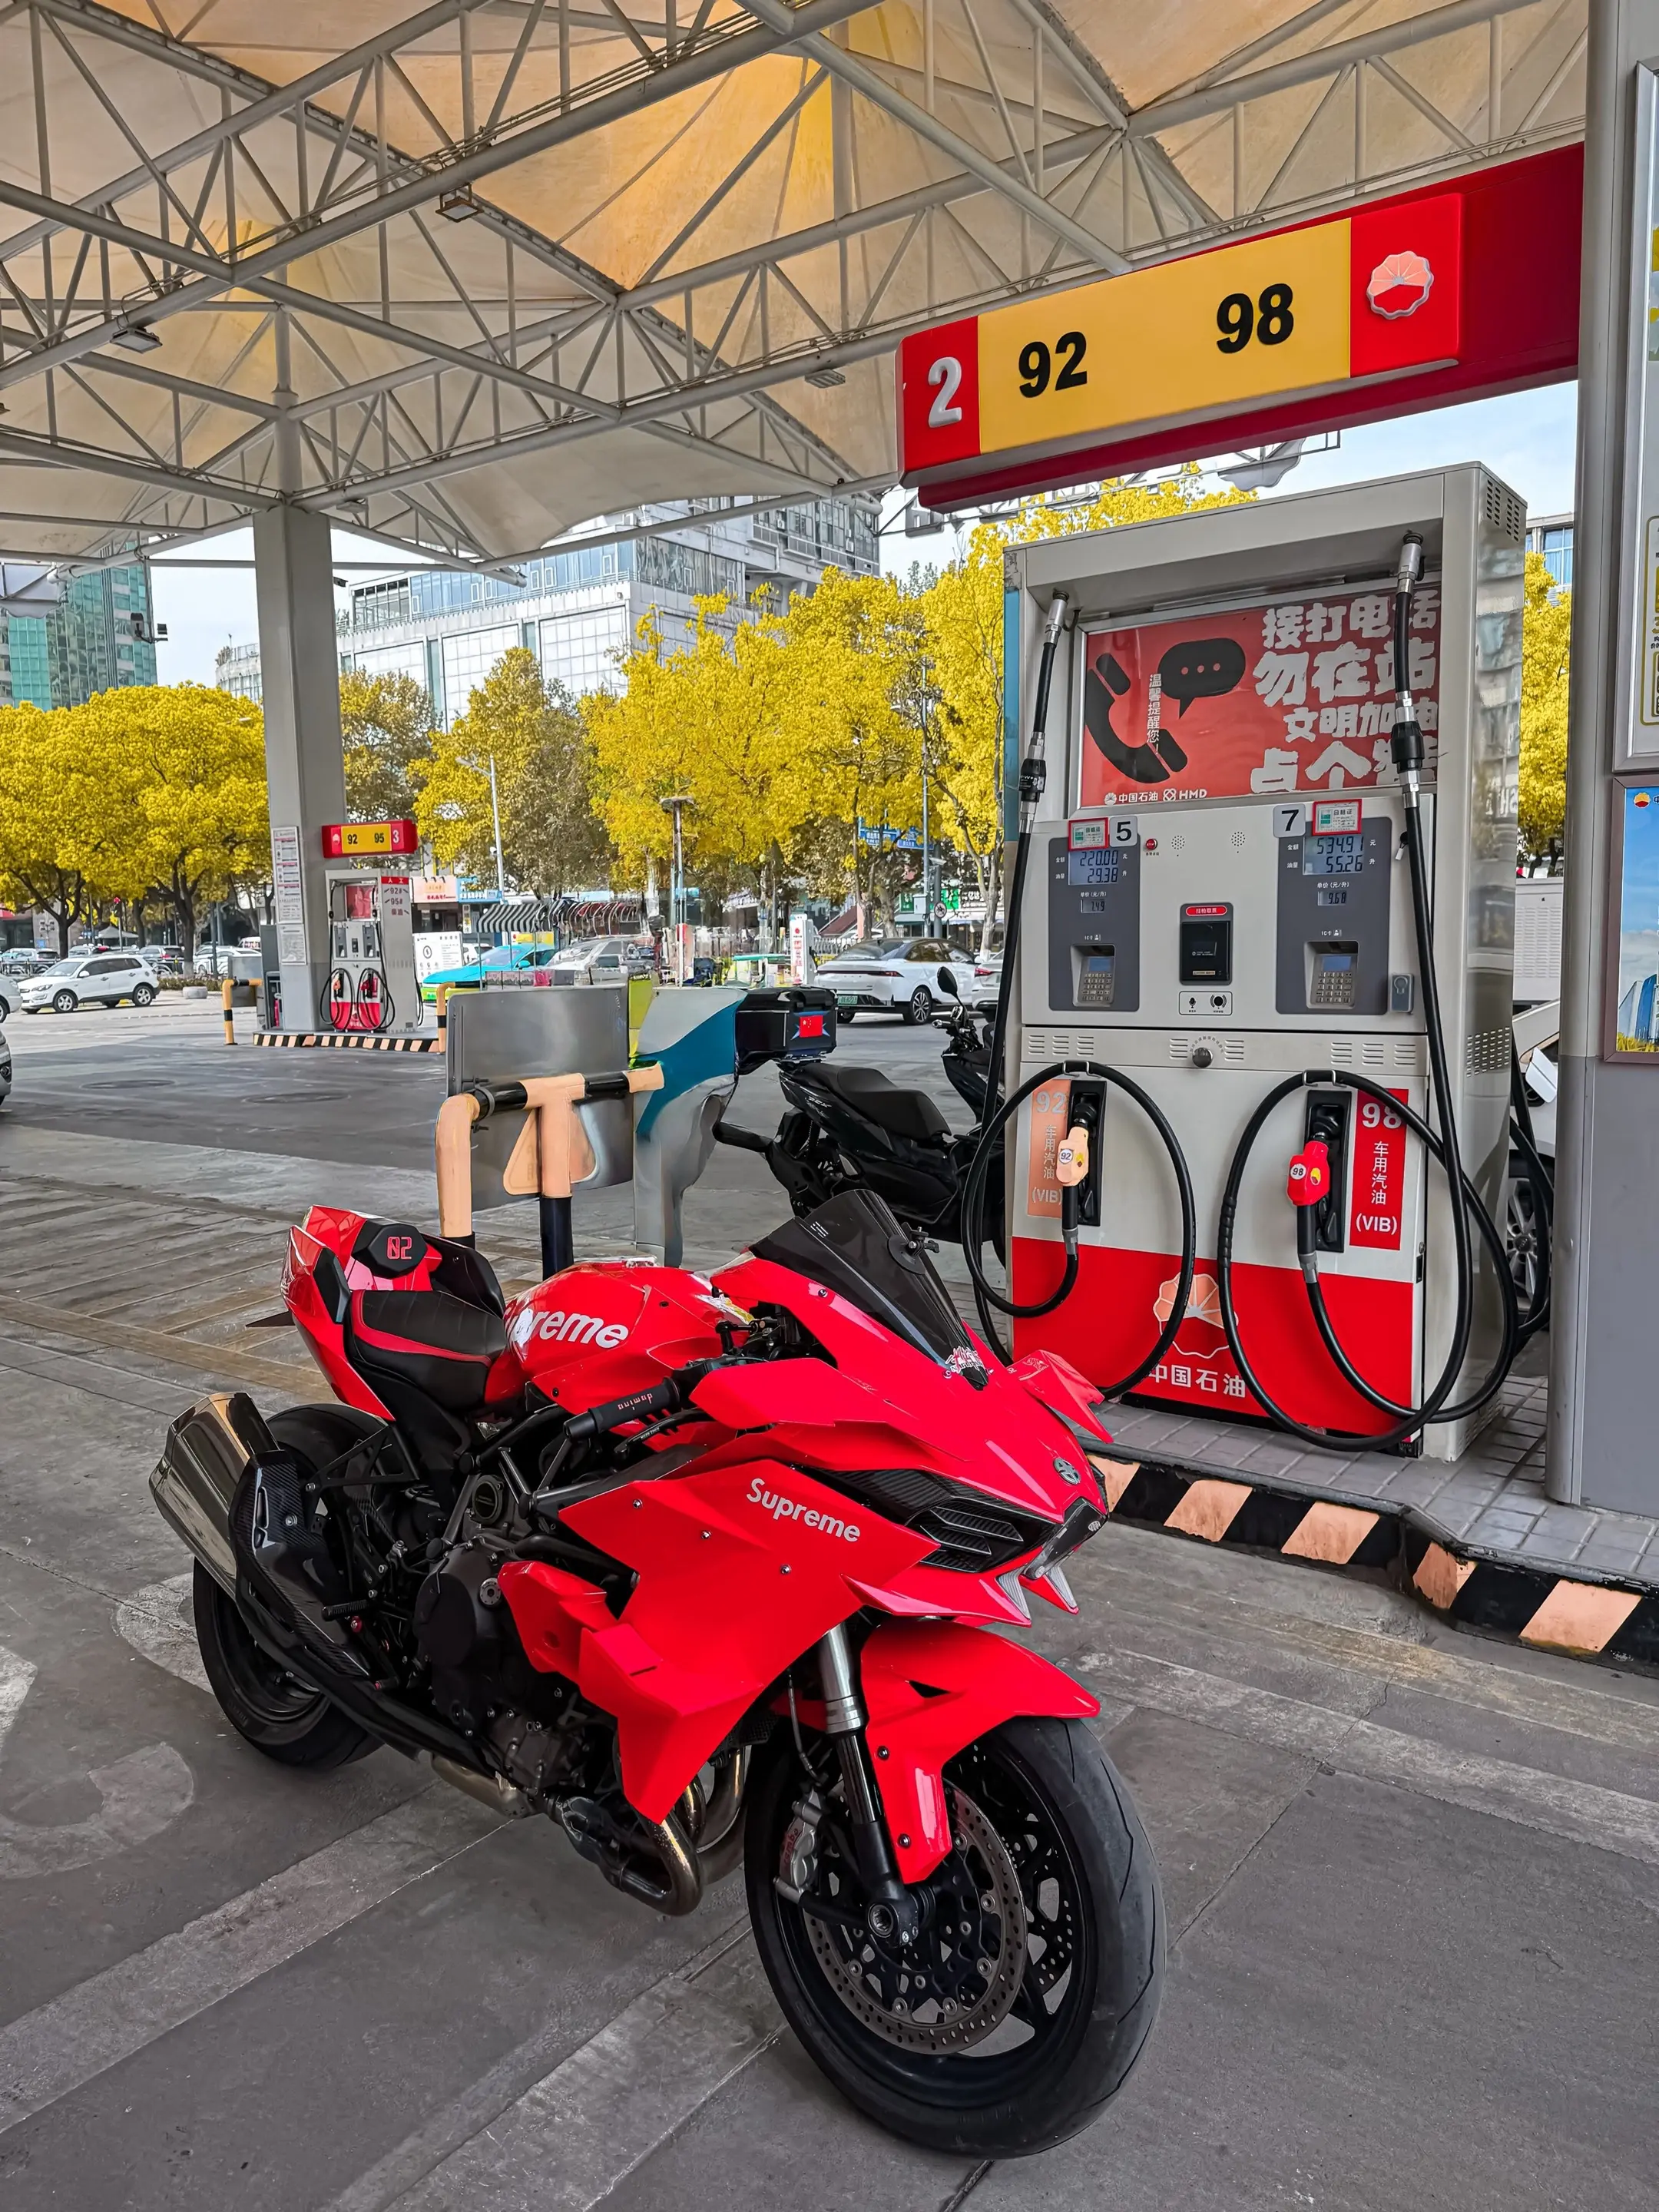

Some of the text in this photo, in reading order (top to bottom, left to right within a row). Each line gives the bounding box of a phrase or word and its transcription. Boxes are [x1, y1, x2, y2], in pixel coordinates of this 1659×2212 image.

[1018, 283, 1294, 398] 92 98
[927, 356, 962, 429] 2
[1118, 791, 1158, 803] 中国石油
[1179, 789, 1207, 800] HMD
[1281, 809, 1300, 832] 7
[347, 830, 399, 844] 92 95 3
[1116, 821, 1132, 842] 5
[1317, 836, 1364, 855] 534.91
[1080, 849, 1118, 866] 220.00
[1326, 854, 1363, 873] 55.26
[1088, 867, 1118, 883] 29.38
[1036, 1091, 1066, 1114] 92
[1362, 1102, 1402, 1129] 98
[1043, 1124, 1058, 1180] 车用汽油
[1060, 1152, 1071, 1161] 92
[1292, 1167, 1303, 1176] 98
[1371, 1141, 1389, 1205] 车用汽油
[1031, 1187, 1063, 1205] (VIB)
[1356, 1212, 1398, 1235] (VIB)
[1148, 1364, 1246, 1398] 中国石油
[618, 1392, 653, 1411] domino
[747, 1478, 861, 1542] Supreme
